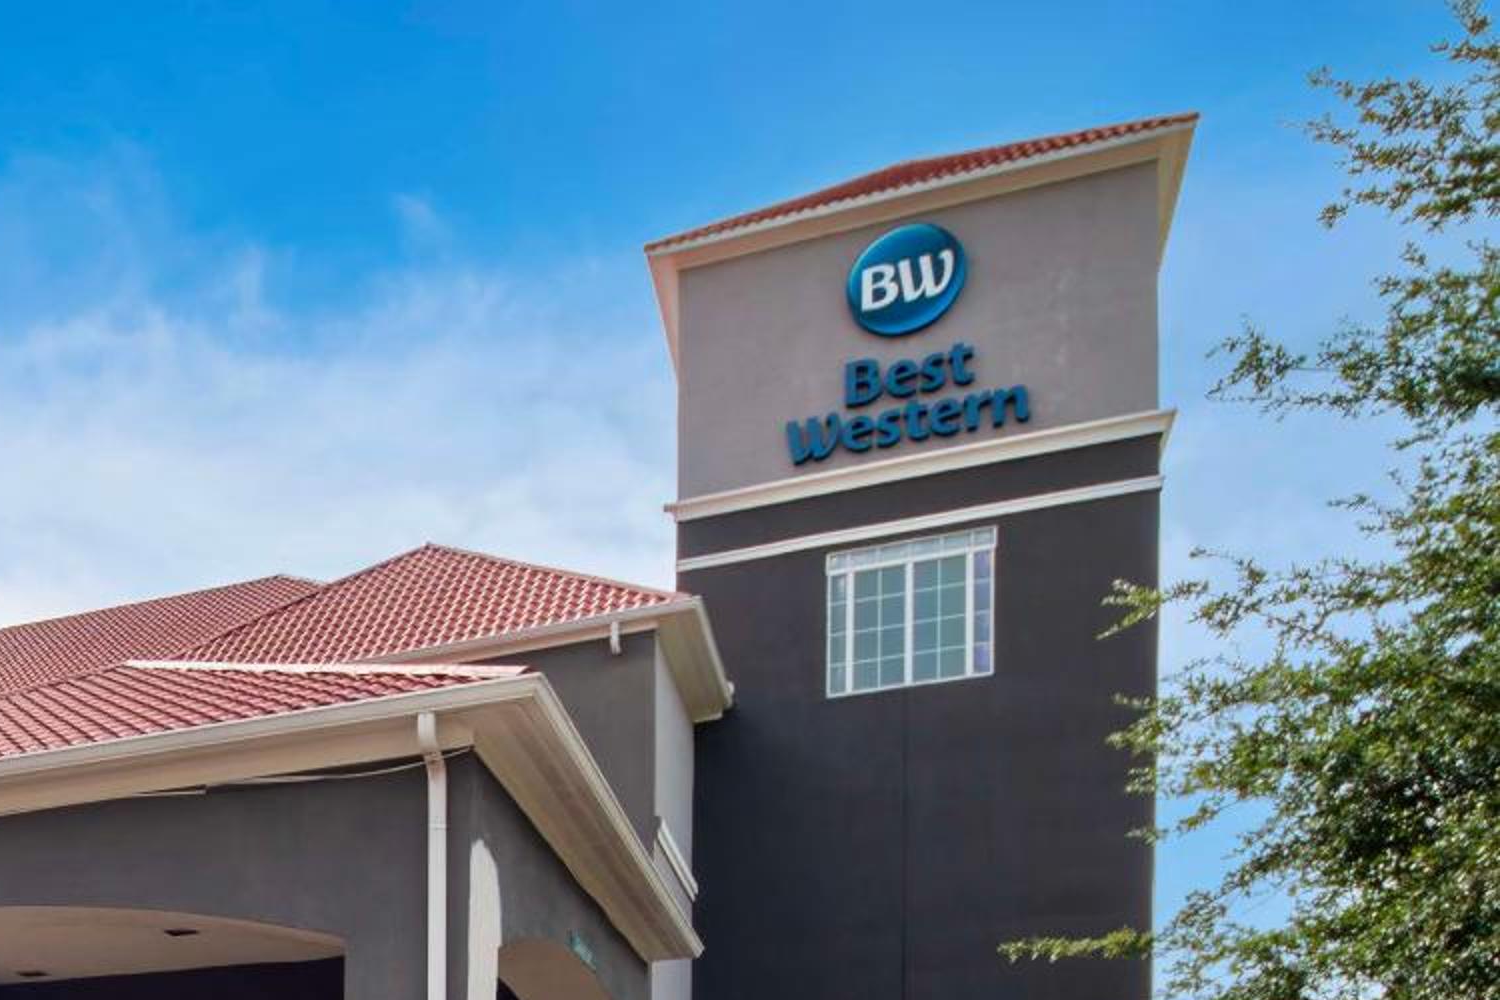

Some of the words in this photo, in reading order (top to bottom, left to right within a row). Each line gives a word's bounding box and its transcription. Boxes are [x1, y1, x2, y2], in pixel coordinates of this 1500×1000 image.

[861, 249, 954, 312] BW
[844, 342, 975, 408] Best
[785, 384, 1030, 466] Western
